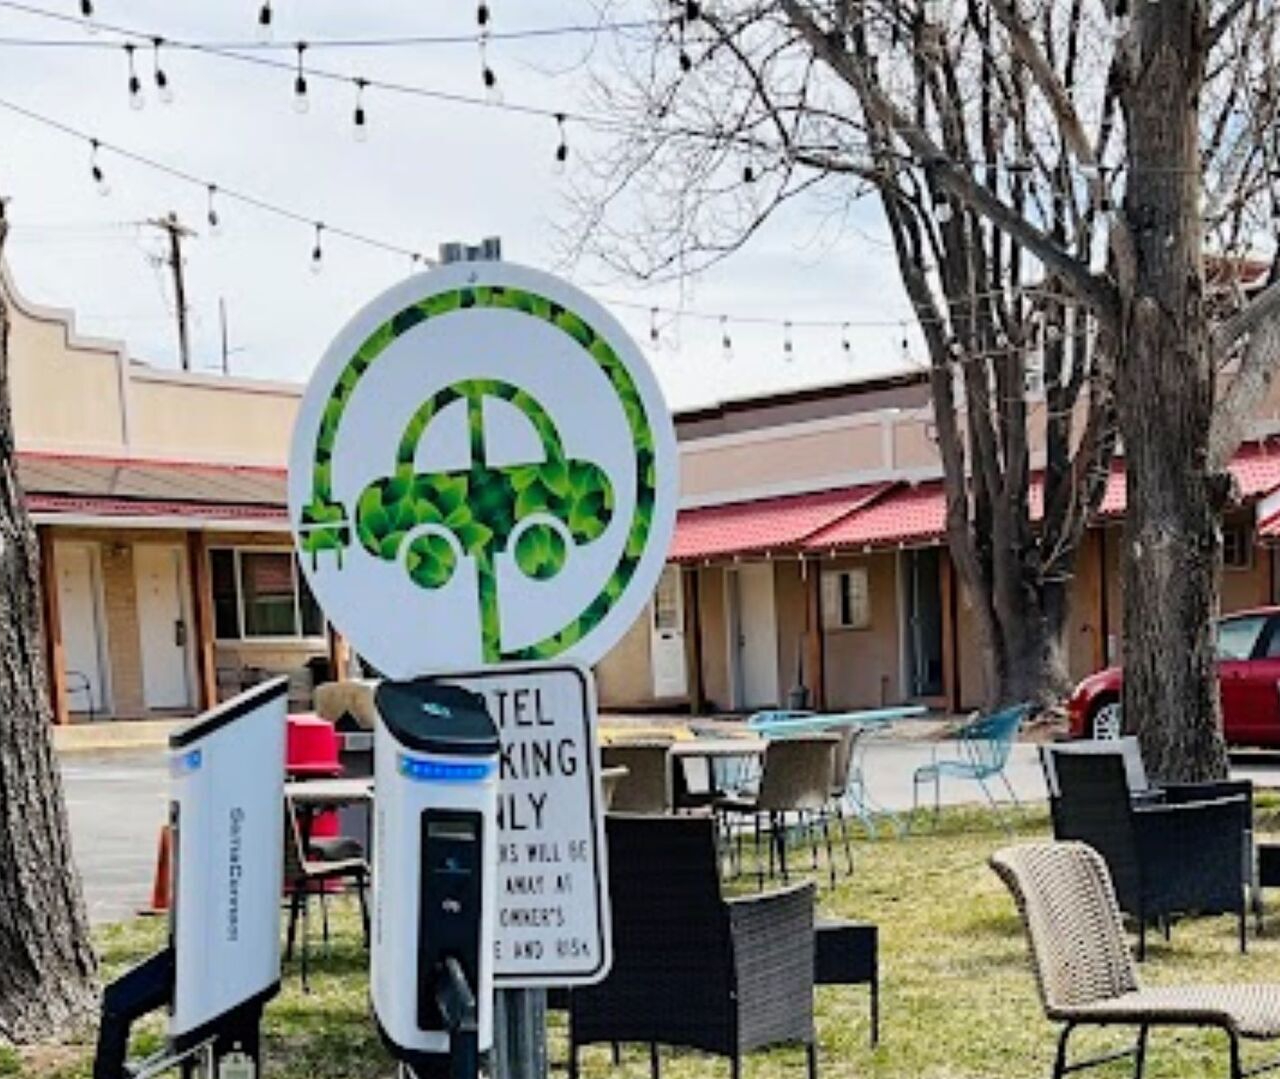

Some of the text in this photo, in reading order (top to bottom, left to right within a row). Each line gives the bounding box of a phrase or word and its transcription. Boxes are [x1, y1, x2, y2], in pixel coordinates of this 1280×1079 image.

[493, 688, 555, 728] TEL
[499, 739, 577, 780] KING
[496, 793, 548, 831] NLY
[525, 840, 562, 863] WILL
[505, 874, 544, 895] AWAY
[513, 940, 545, 961] AND
